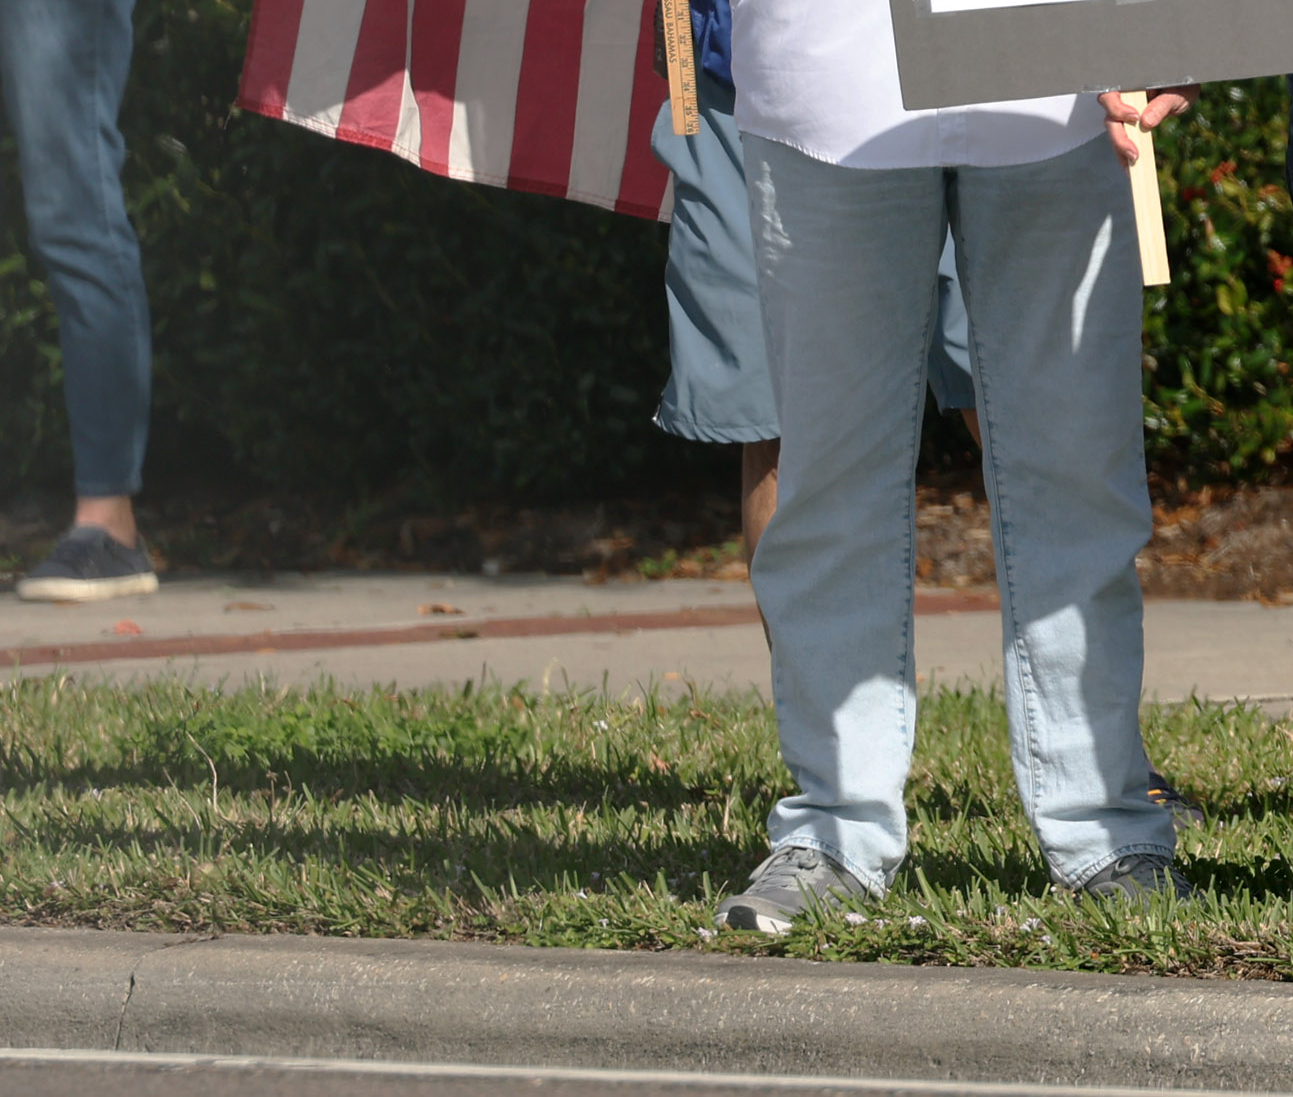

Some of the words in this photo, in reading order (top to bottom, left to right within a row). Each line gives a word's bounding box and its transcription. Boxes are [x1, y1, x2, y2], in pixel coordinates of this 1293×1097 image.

[677, 10, 685, 21] 31
[666, 22, 677, 64] BAHAMAS
[681, 58, 689, 68] 33
[683, 82, 690, 91] 34
[685, 106, 693, 116] 35
[686, 122, 695, 133] 36
